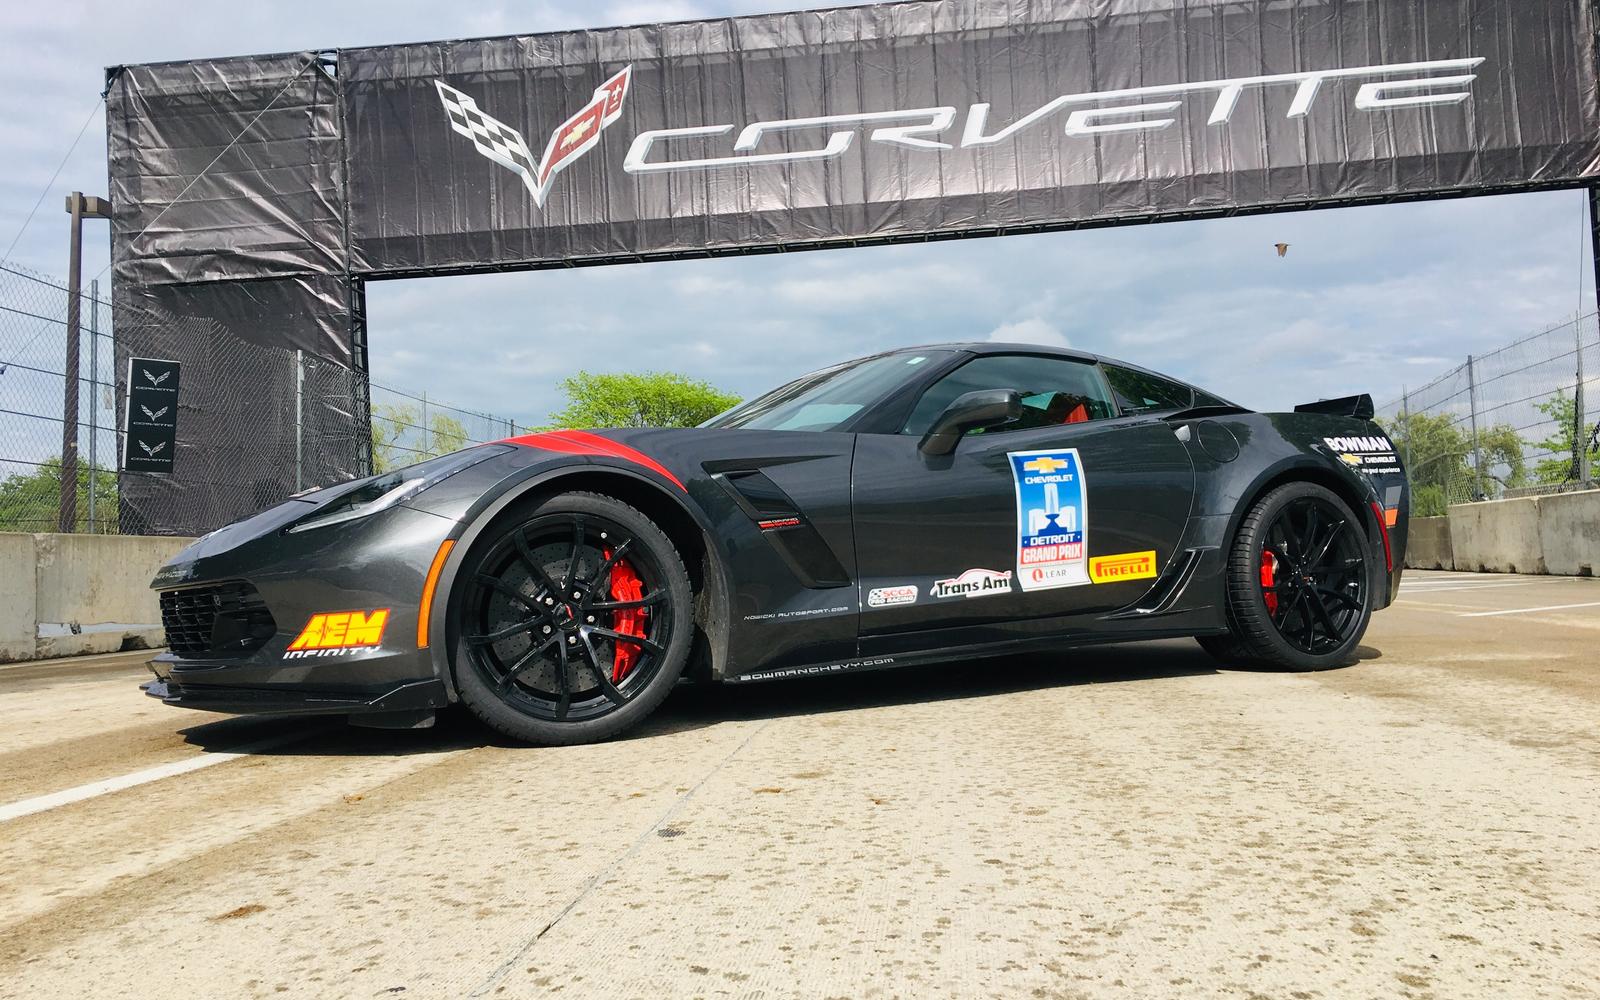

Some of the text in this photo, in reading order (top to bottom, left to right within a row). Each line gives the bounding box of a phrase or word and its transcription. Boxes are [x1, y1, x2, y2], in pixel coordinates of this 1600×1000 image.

[624, 56, 1486, 174] CORVETTE
[1323, 436, 1392, 452] BOWMAN
[1364, 456, 1396, 464] CHEVROLET
[1024, 473, 1074, 485] CHEVROLET
[1030, 533, 1076, 547] DETROIT
[1023, 543, 1081, 563] GRAND PRIX
[1045, 569, 1067, 579] LEAR
[1095, 557, 1150, 578] PIRELLI
[883, 589, 914, 598] SCCA
[937, 576, 1008, 596] Trans Am
[287, 608, 391, 651] AEM
[282, 646, 381, 660] INFINITY
[740, 657, 894, 681] BOWMANCHEVY.COM
